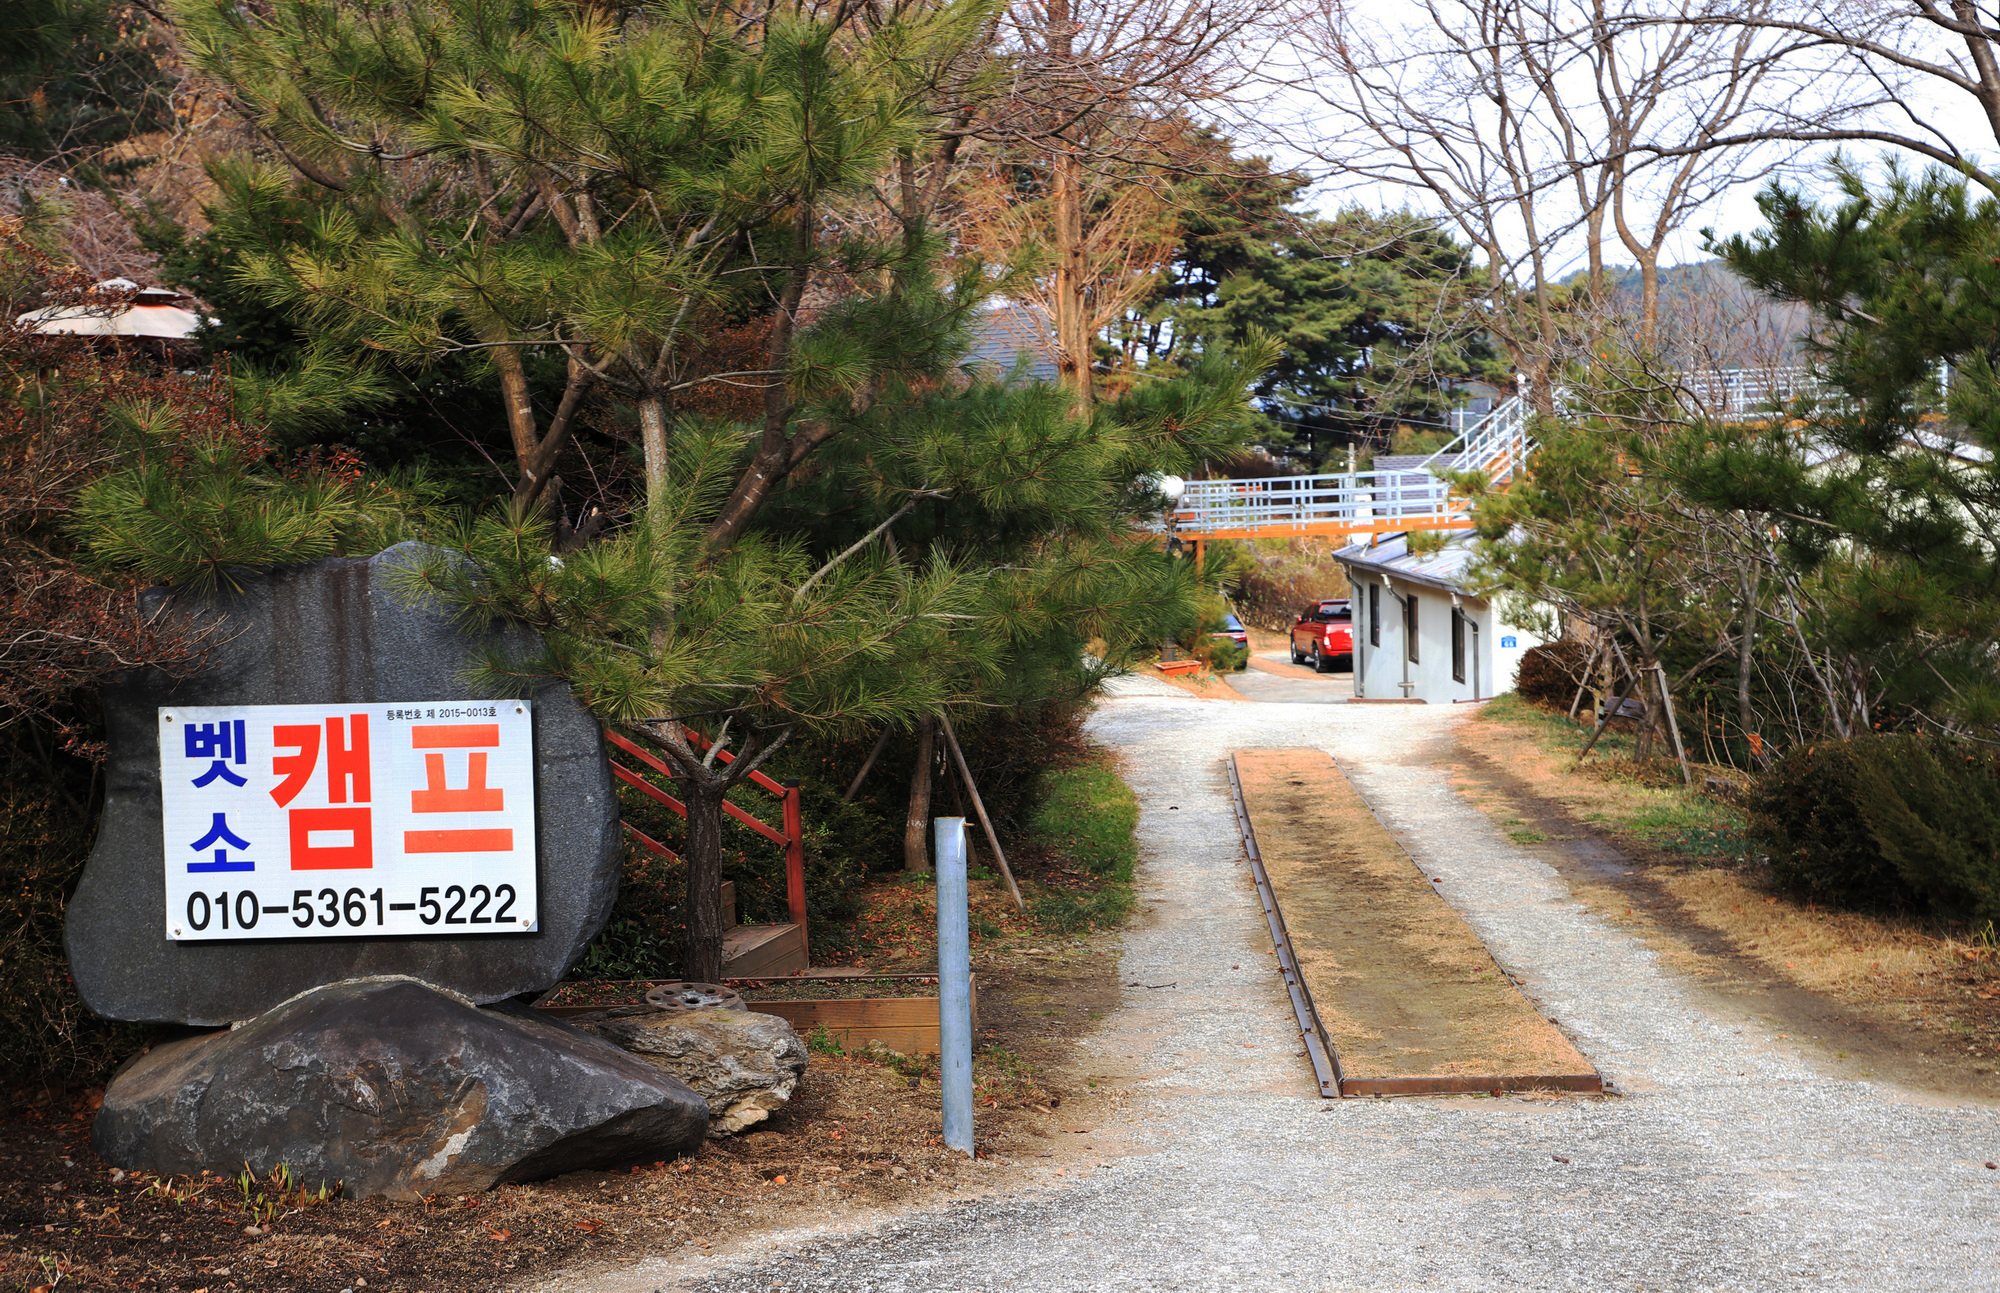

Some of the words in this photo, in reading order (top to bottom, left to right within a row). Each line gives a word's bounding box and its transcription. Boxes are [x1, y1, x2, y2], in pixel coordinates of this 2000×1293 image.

[386, 709, 422, 721] 등록번호
[426, 708, 436, 719] 제
[439, 706, 497, 718] 2015-0013호
[268, 713, 514, 870] 캠프
[186, 884, 517, 932] 010-5361-5222
